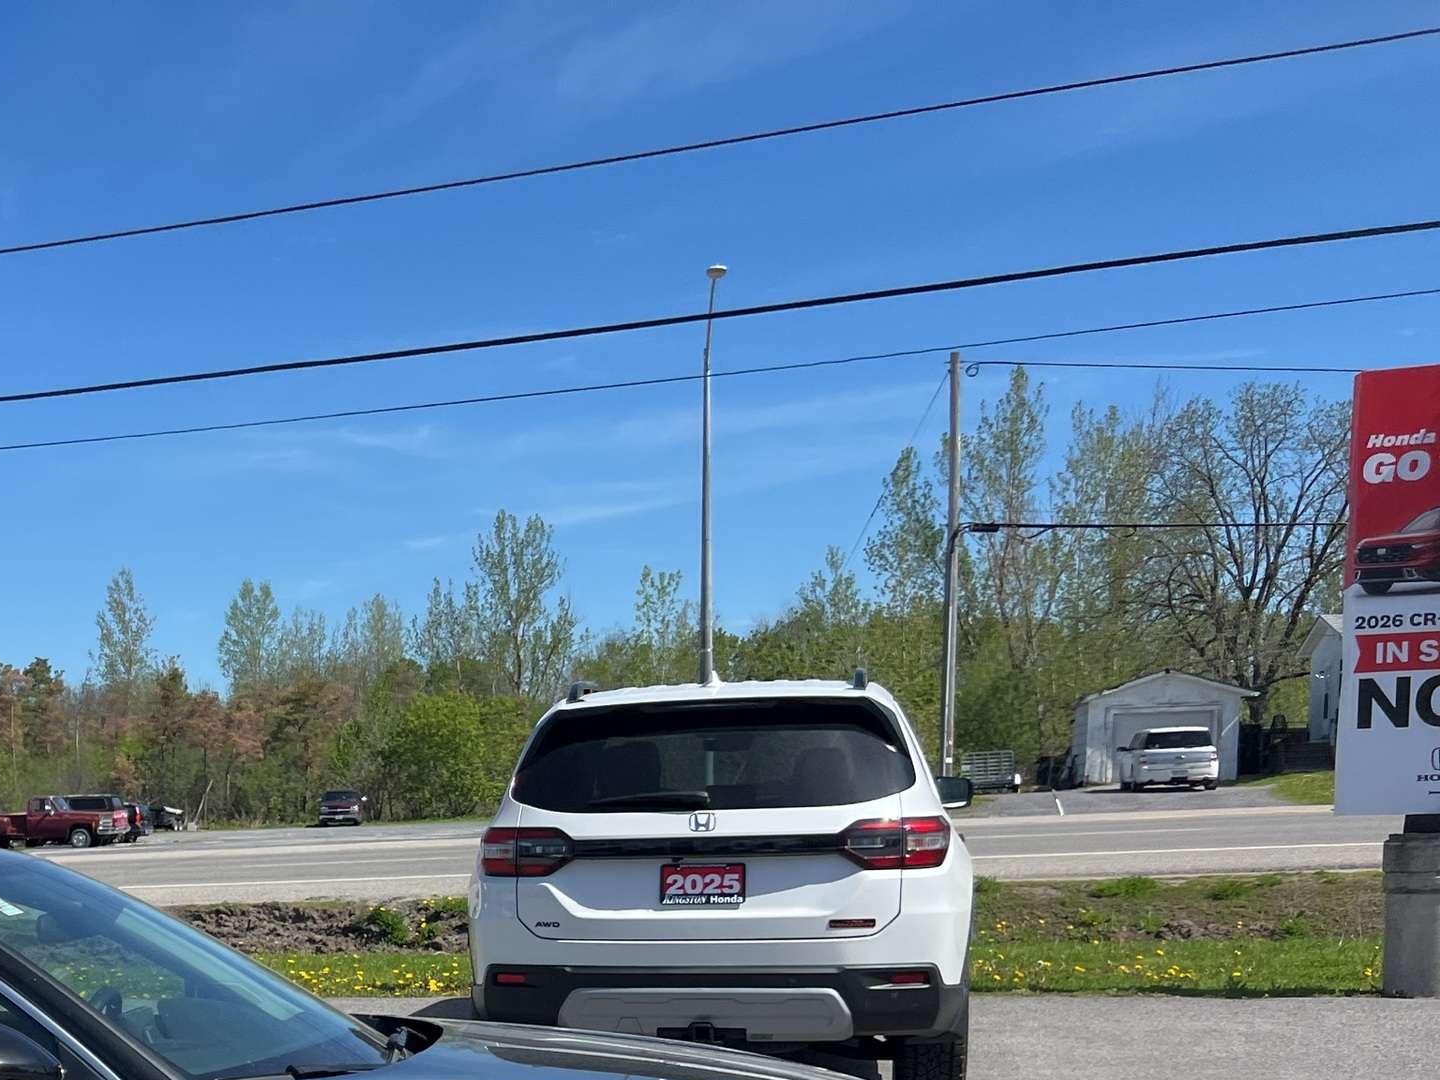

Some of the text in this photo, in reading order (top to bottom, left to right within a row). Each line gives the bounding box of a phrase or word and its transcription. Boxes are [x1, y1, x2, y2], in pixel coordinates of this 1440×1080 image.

[1366, 428, 1437, 449] Honda
[1363, 450, 1431, 484] GO
[1354, 614, 1404, 630] 2026
[1375, 641, 1409, 664] IN
[665, 873, 741, 895] 2025
[710, 894, 743, 904] Honda
